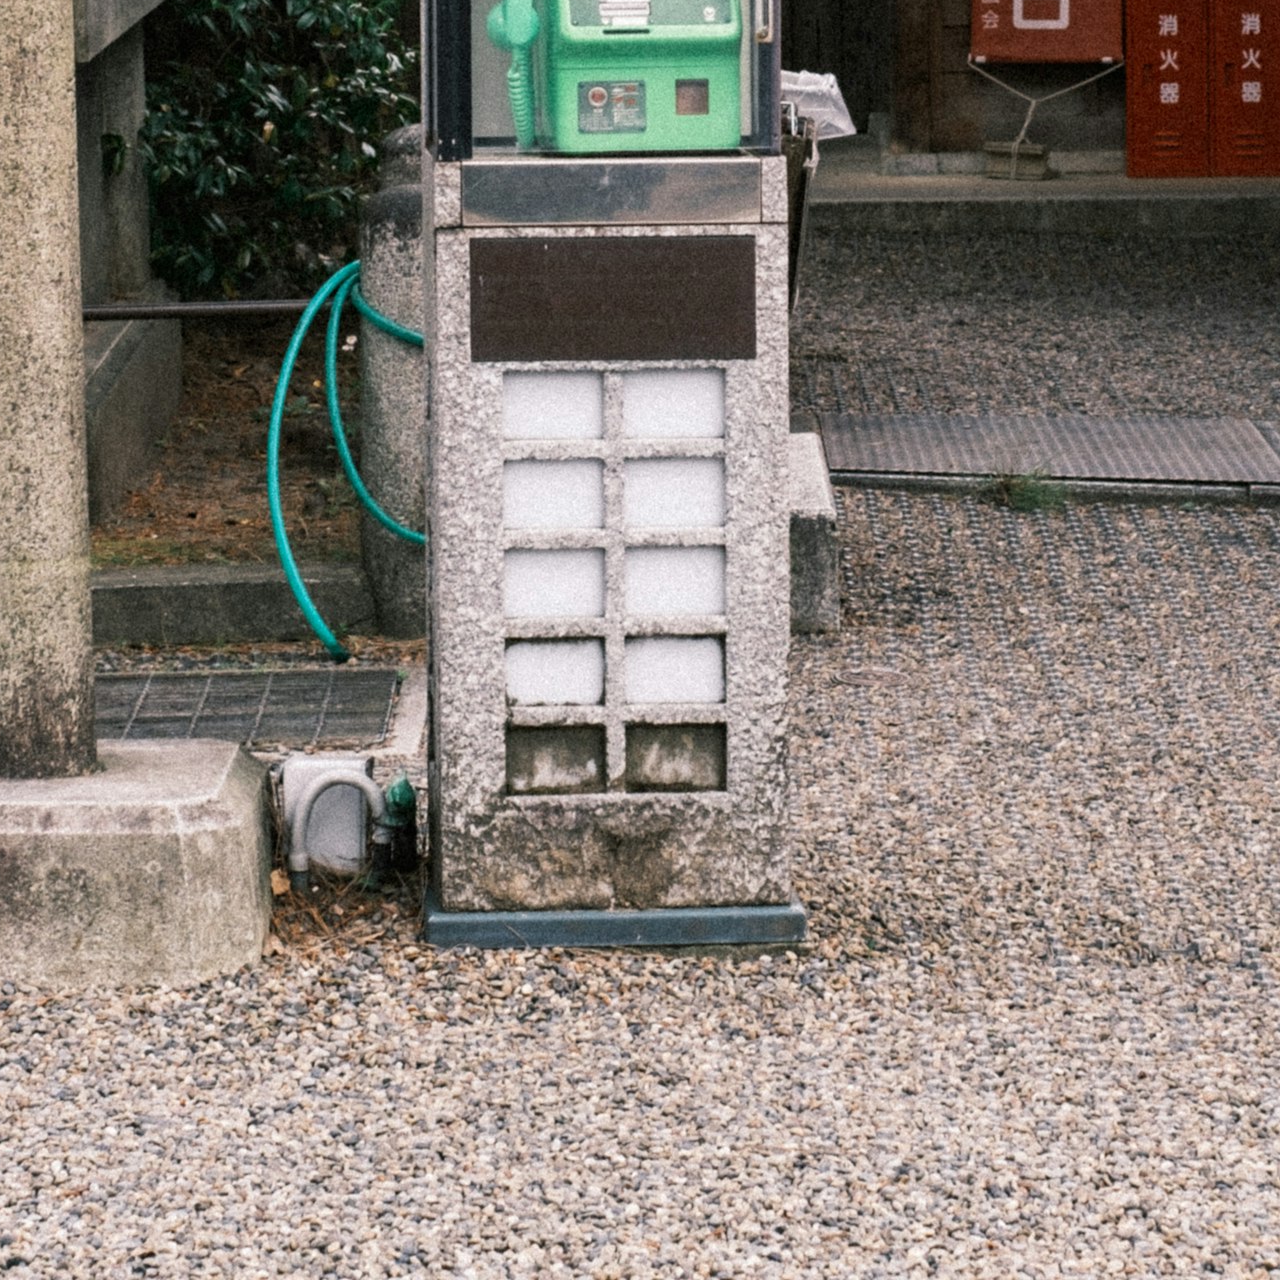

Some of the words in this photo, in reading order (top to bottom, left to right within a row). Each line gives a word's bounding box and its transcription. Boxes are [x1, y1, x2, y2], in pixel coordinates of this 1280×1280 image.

[1159, 15, 1180, 104] 消火器
[1241, 14, 1262, 103] 消火器
